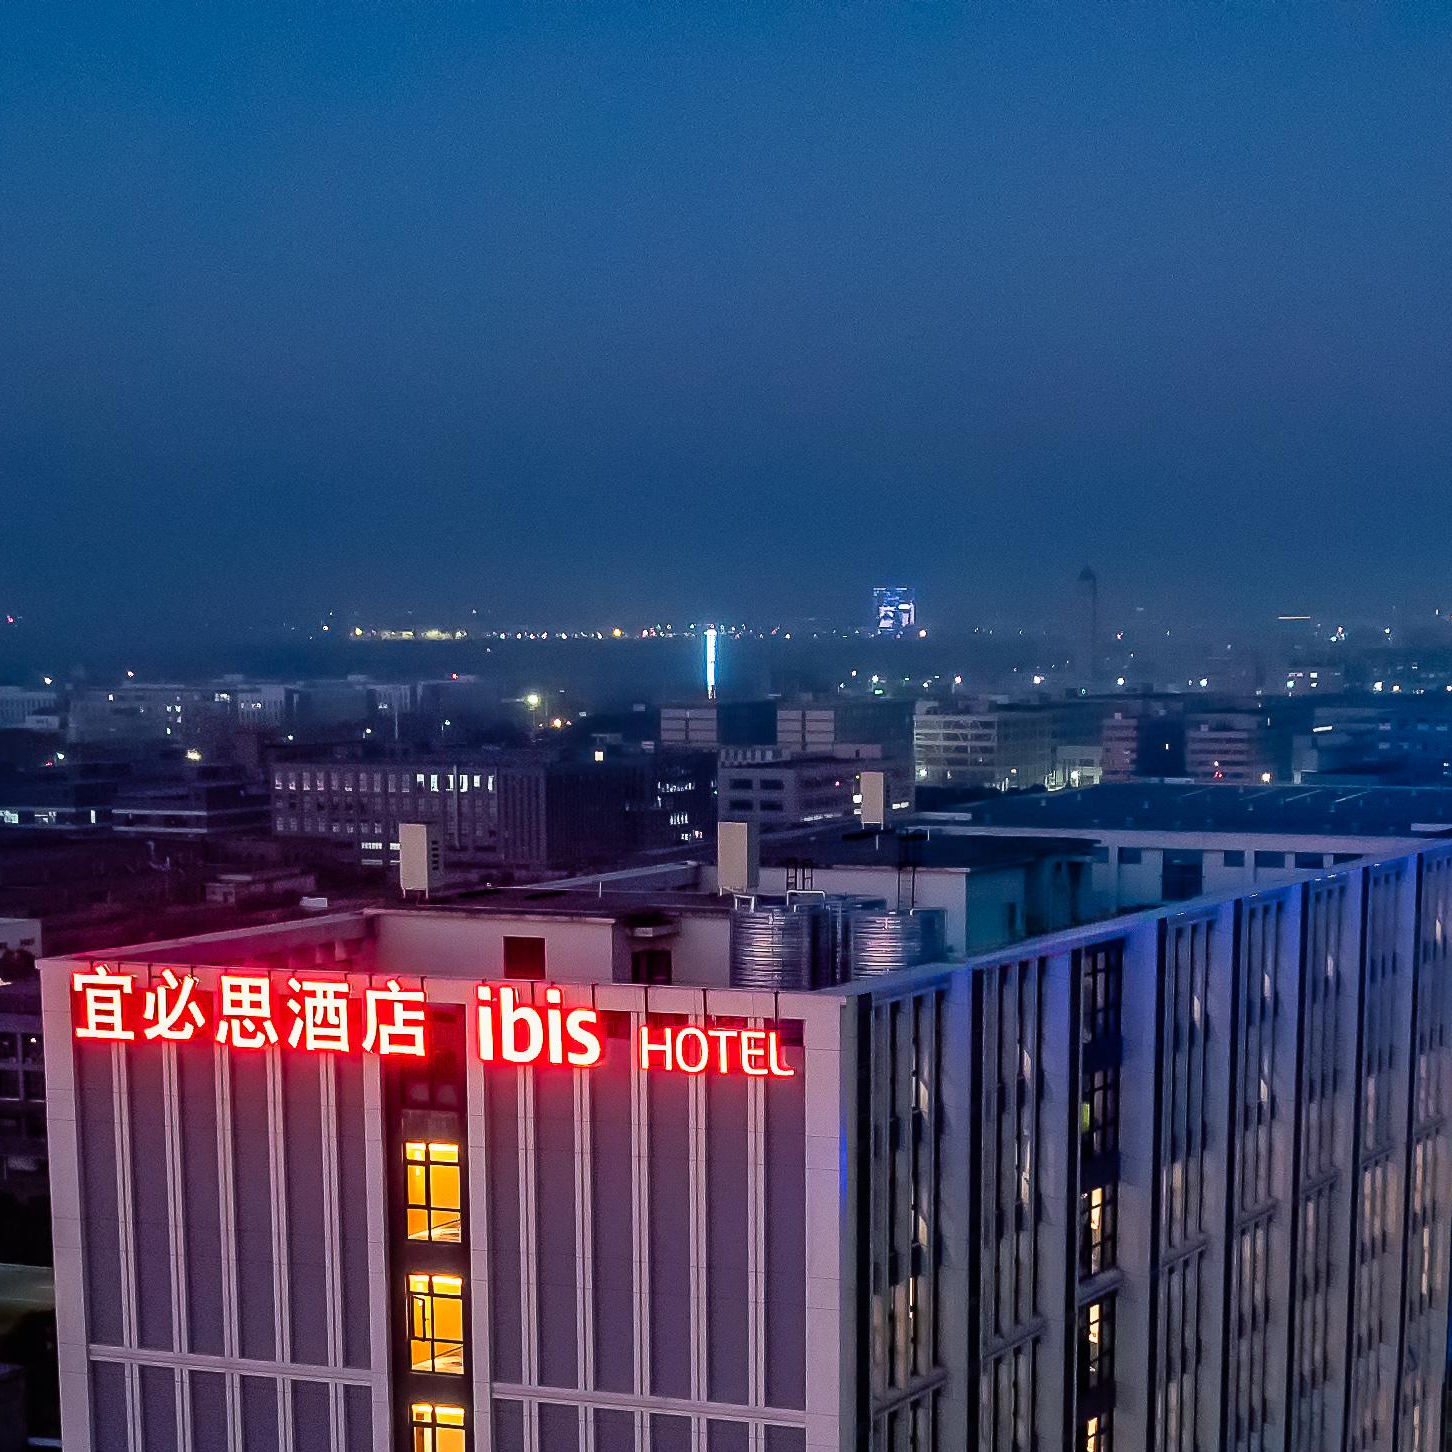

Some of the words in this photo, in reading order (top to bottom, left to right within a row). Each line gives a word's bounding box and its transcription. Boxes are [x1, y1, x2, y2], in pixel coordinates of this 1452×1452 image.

[72, 965, 427, 1057] 宜必思酒店
[477, 985, 602, 1066] ibis
[640, 1026, 795, 1077] HOTEL
